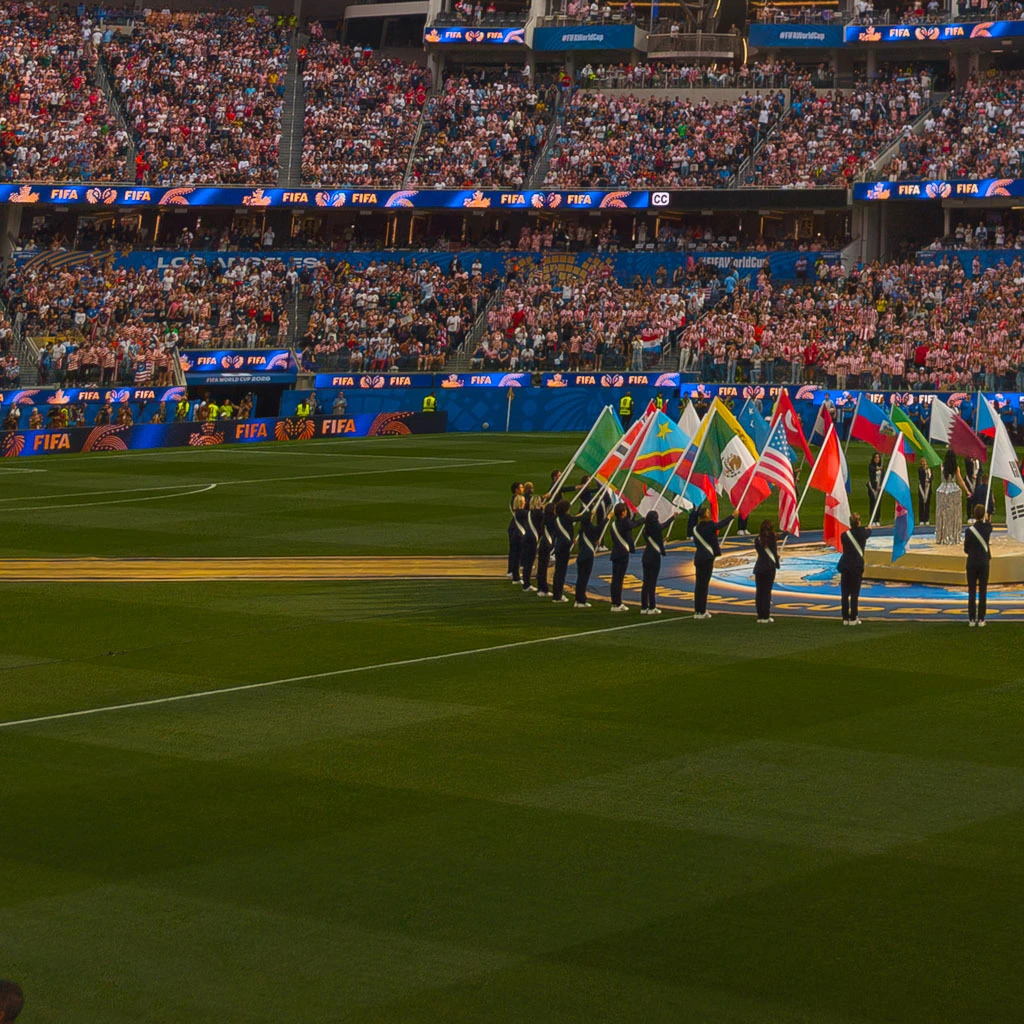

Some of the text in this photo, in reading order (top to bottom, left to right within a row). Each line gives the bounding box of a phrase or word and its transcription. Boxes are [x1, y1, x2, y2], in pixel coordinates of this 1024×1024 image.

[445, 30, 462, 39] FIFA
[487, 31, 503, 40] FIFA
[779, 32, 825, 41] #FIFAWorldCup
[889, 28, 910, 38] FIFA
[945, 27, 964, 37] FIFA
[50, 189, 78, 199] FIFA
[898, 185, 920, 195] FIFA
[957, 184, 979, 194] FIFA
[124, 190, 151, 201] FIFA
[282, 192, 308, 203] FIFA
[352, 193, 377, 203] FIFA
[501, 194, 525, 204] FIFA
[567, 195, 592, 205] FIFA
[653, 195, 668, 204] CC
[197, 357, 217, 366] FIFA
[247, 356, 266, 365] FIFA
[332, 377, 354, 387] FIFA
[390, 377, 411, 387] FIFA
[471, 376, 491, 385] FIFA
[576, 376, 596, 385] FIFA
[628, 376, 648, 385] FIFA
[78, 391, 100, 401] FIFA
[134, 390, 155, 400] FIFA
[719, 387, 738, 396] FIFA
[870, 394, 884, 403] IFA
[919, 394, 934, 403] FIF
[235, 423, 267, 439] FIFA
[322, 419, 356, 434] FIFA
[33, 433, 70, 450] FIFA
